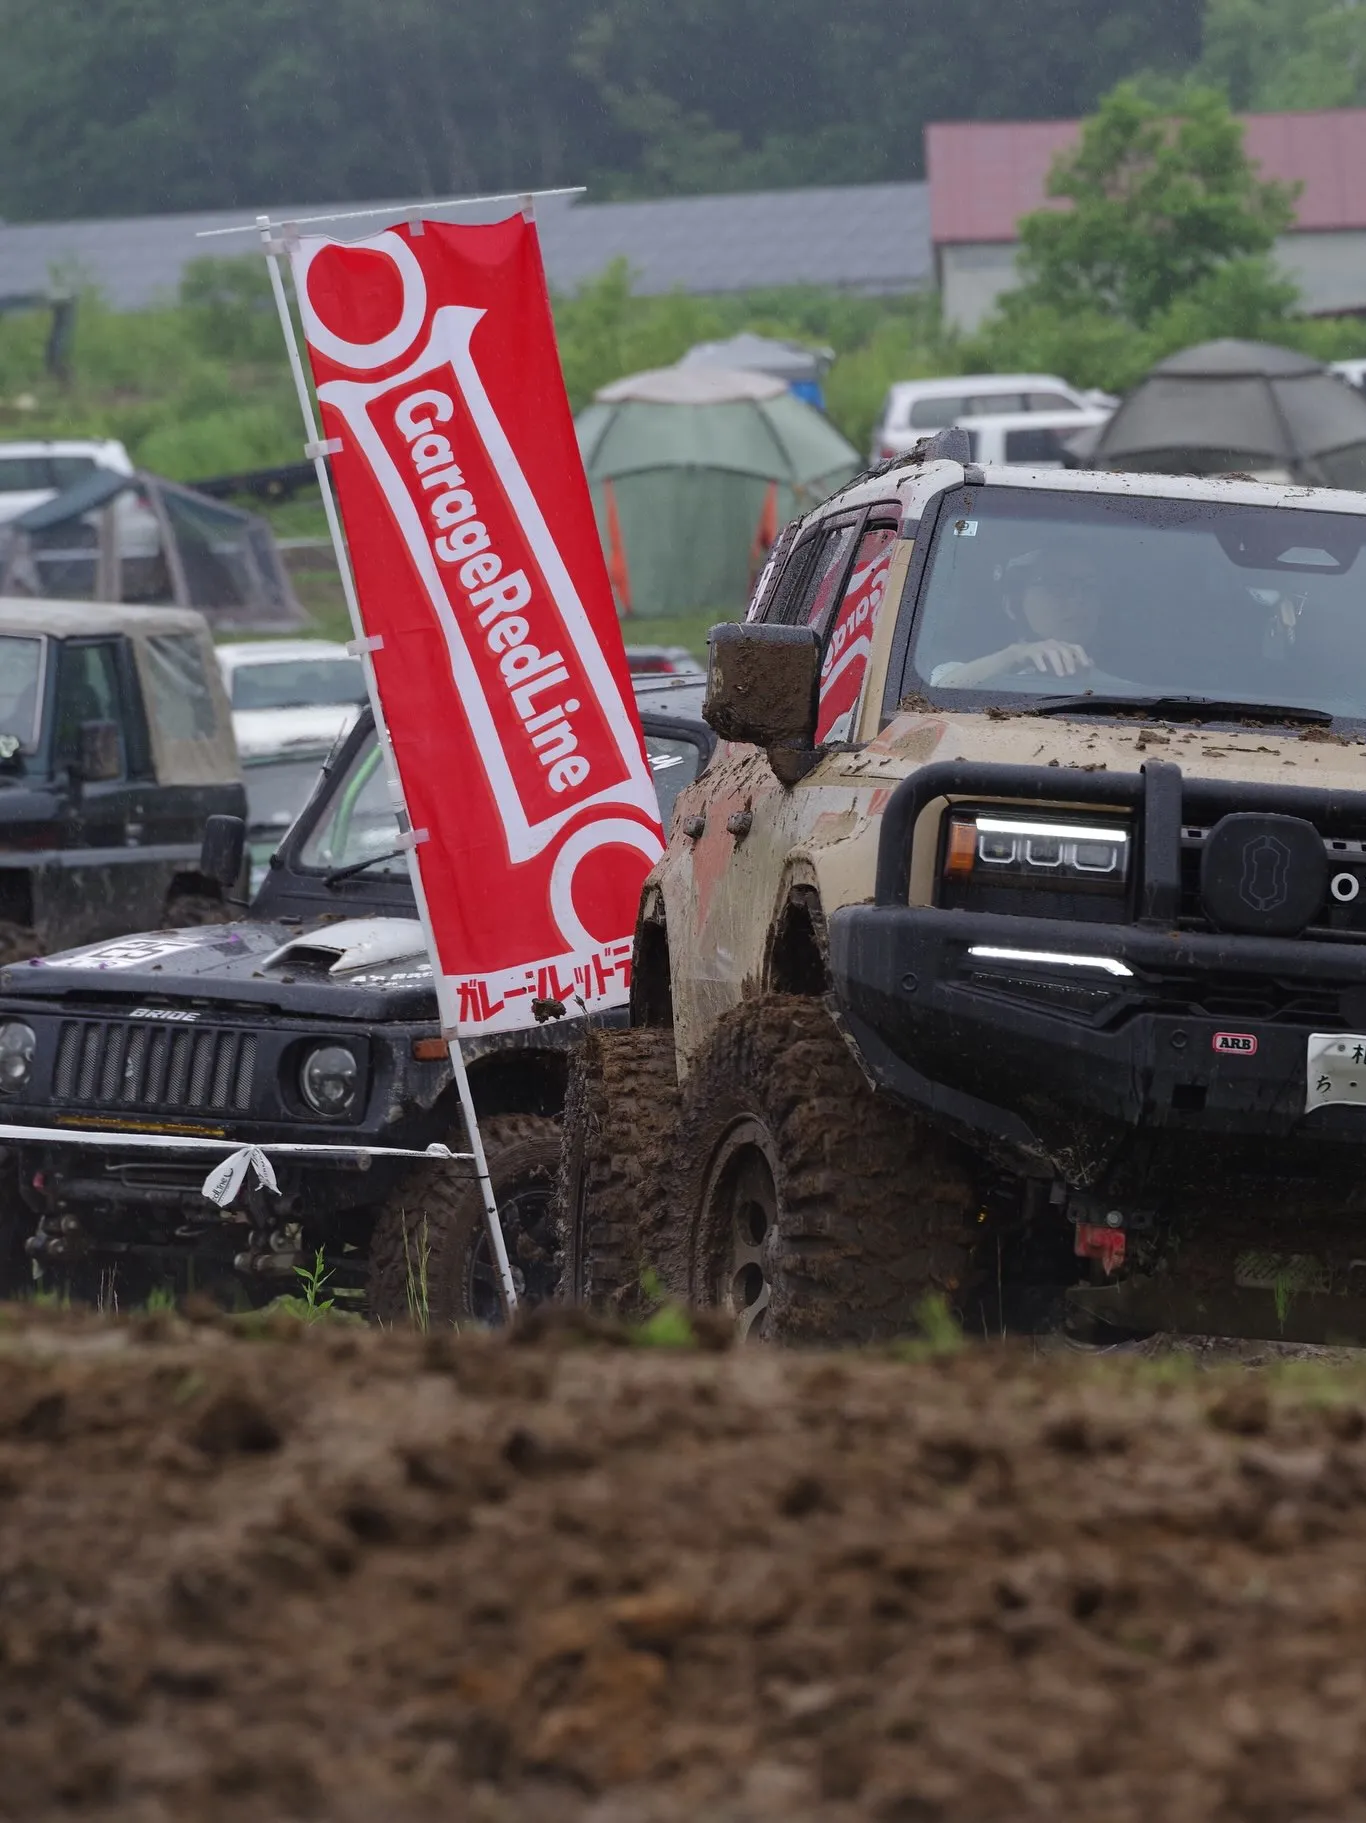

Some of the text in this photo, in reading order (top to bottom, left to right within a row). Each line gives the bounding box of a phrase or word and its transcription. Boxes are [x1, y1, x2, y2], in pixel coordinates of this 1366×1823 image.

[394, 389, 590, 794] GarageRedLine
[129, 1008, 201, 1022] BRIDE
[1219, 1037, 1252, 1050] ARB
